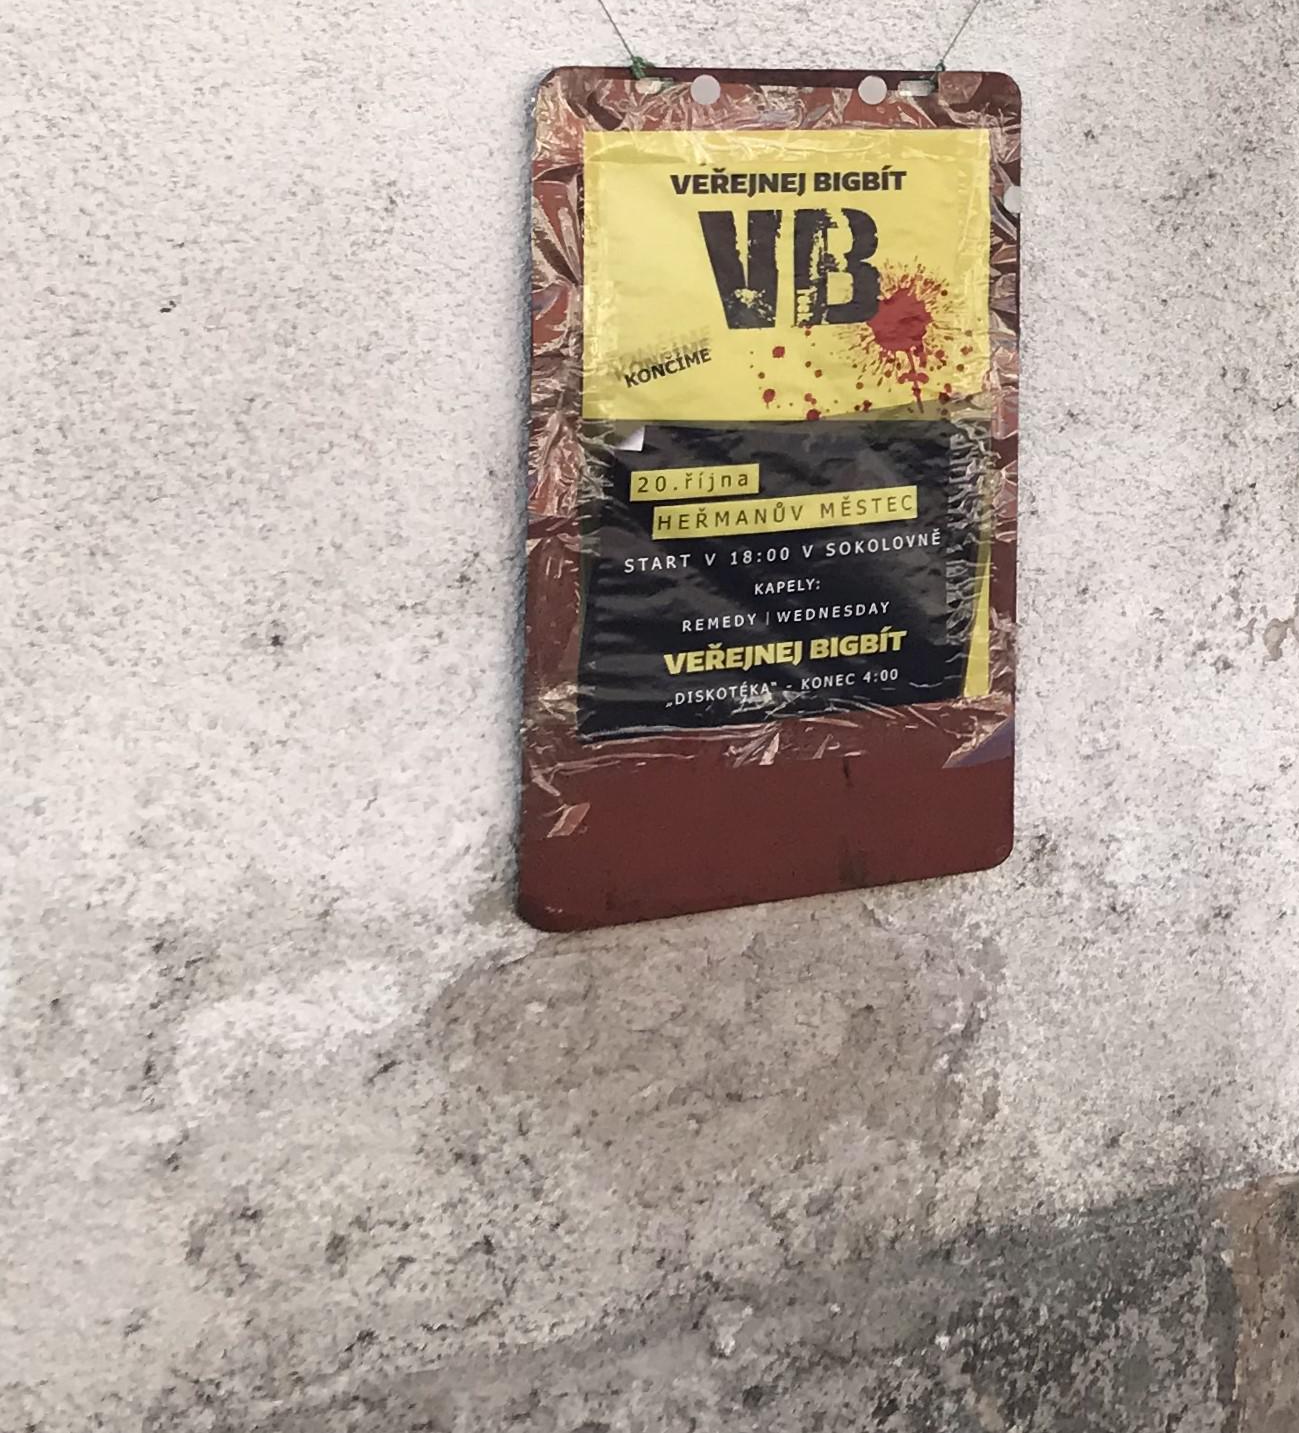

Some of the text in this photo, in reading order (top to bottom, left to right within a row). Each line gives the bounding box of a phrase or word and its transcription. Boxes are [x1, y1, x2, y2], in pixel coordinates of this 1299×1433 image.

[670, 164, 907, 197] VEŘEJNEJ BIGBÍT
[697, 207, 881, 330] VB
[623, 347, 712, 388] KONČÍME
[656, 494, 913, 531] HEŘMANŮV MĚSTEC
[624, 527, 942, 574] START V 18:00 V SOKOLOVNĚ
[754, 577, 822, 596] KAPELY:
[682, 600, 891, 634] REMEDY WEDNESDAY
[663, 625, 908, 676] VEŘEJNEJ BIGBÍT
[801, 673, 856, 691] KONEC
[863, 667, 899, 684] 4:00
